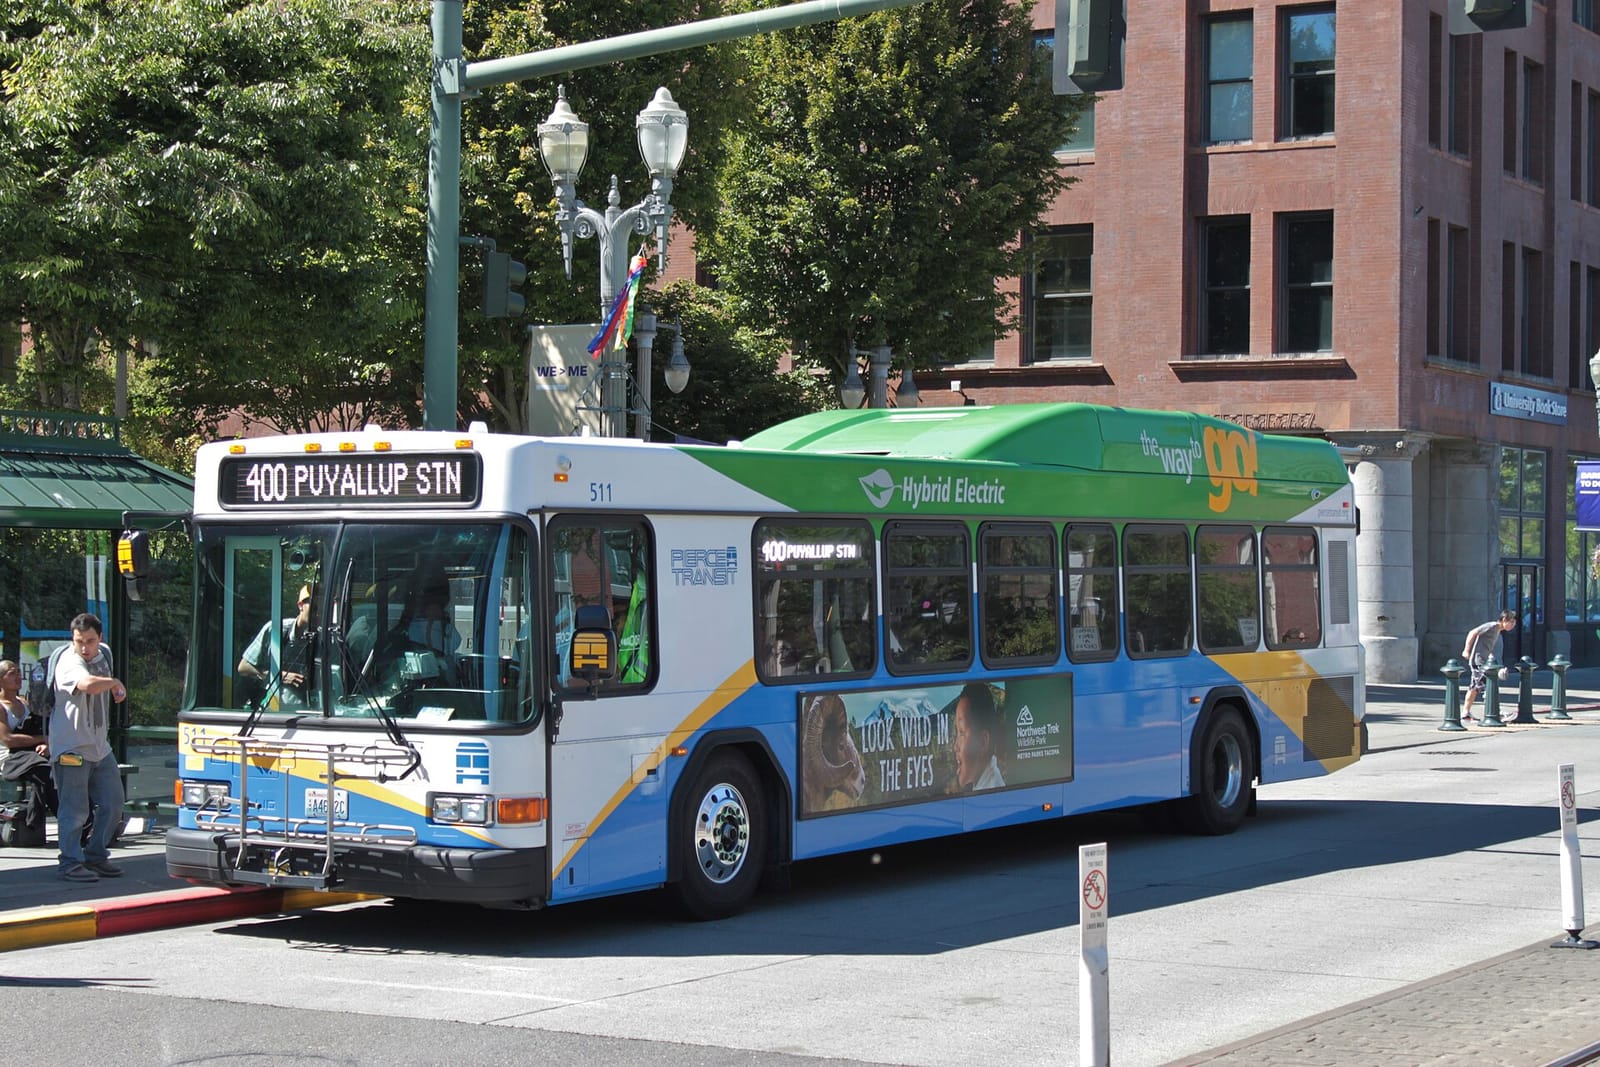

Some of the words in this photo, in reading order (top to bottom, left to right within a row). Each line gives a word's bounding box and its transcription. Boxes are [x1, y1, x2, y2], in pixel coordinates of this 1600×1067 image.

[537, 366, 557, 377] WE
[568, 365, 588, 377] ME
[1503, 391, 1535, 417] University
[1536, 399, 1552, 413] Book
[1552, 401, 1567, 417] Store
[1140, 430, 1159, 457] the
[1190, 437, 1202, 459] to
[246, 463, 288, 502] 400
[294, 462, 409, 497] PUYALLUP
[416, 461, 461, 495] STN
[1580, 480, 1591, 488] TO
[590, 482, 612, 502] 511
[901, 476, 952, 509] Hybrid
[955, 478, 1006, 505] Electric
[671, 548, 727, 567] PIERCE
[762, 540, 786, 562] 400
[786, 543, 834, 559] PUYALLUP
[836, 543, 856, 559] STN
[671, 567, 738, 586] TRANSIT
[861, 717, 895, 753] LOOK
[900, 714, 933, 749] WILD
[937, 712, 949, 745] IN
[1016, 725, 1047, 737] Northwest
[1047, 722, 1060, 734] Trek
[1036, 735, 1047, 745] Park
[879, 758, 901, 793] THE
[906, 754, 934, 790] EYES
[312, 799, 345, 814] A462C
